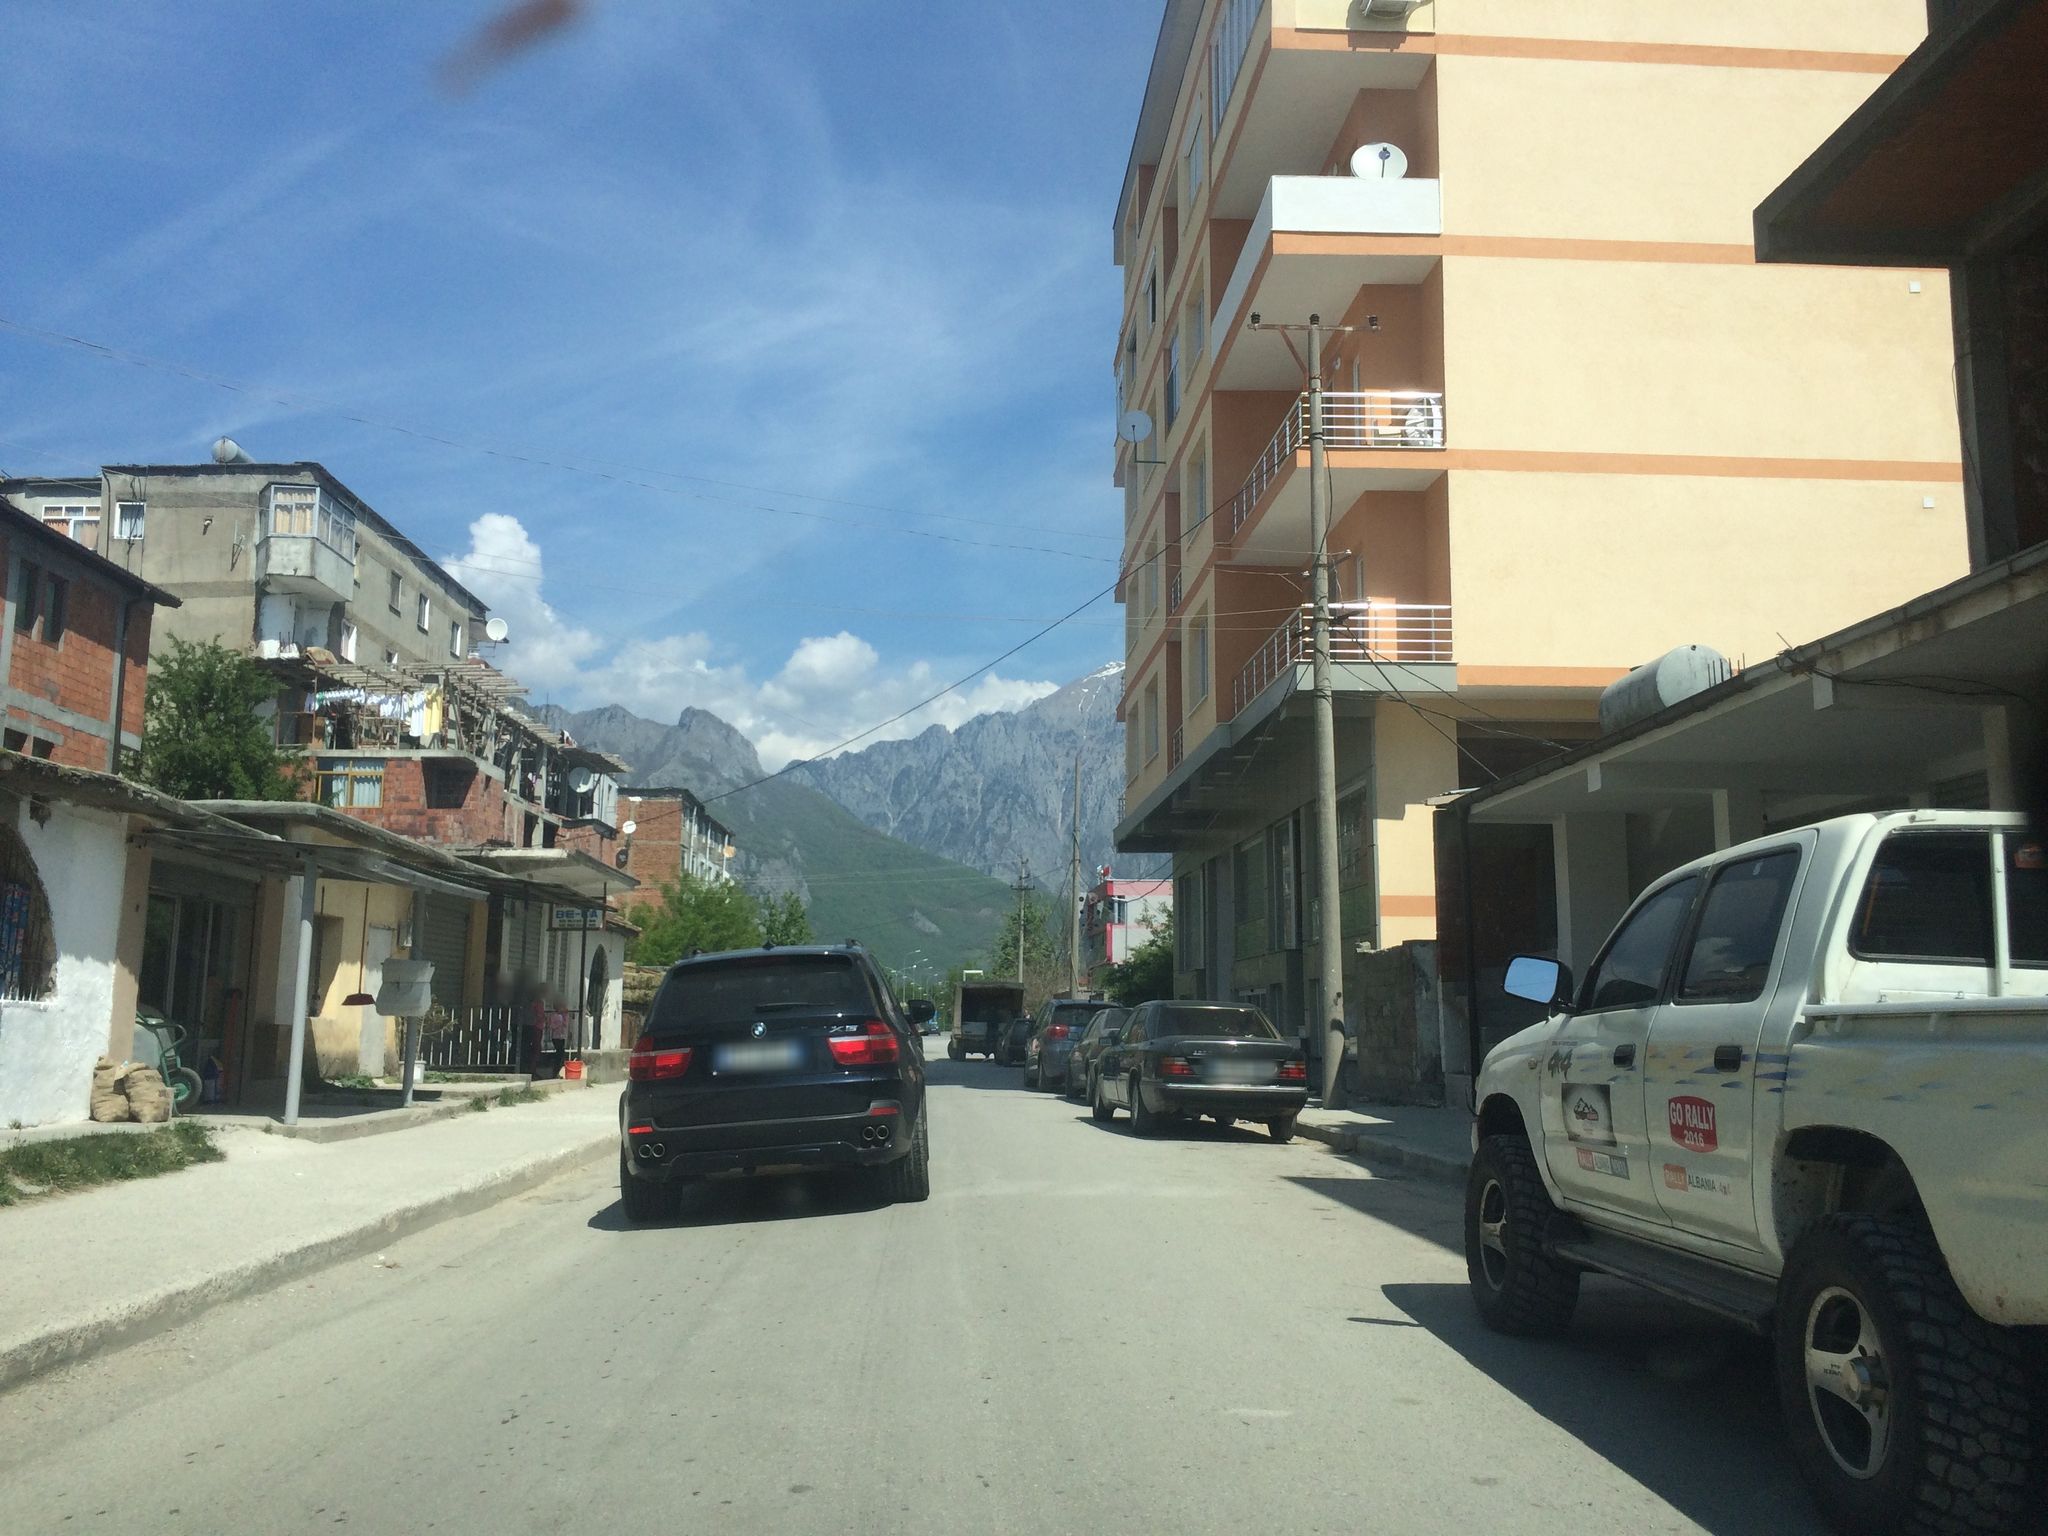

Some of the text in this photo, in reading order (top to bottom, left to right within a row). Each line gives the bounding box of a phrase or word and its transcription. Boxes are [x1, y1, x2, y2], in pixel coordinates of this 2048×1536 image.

[1670, 1102, 1714, 1130] GO RALLY
[1684, 1129, 1705, 1147] 2016
[1687, 1174, 1717, 1192] ALBANIA
